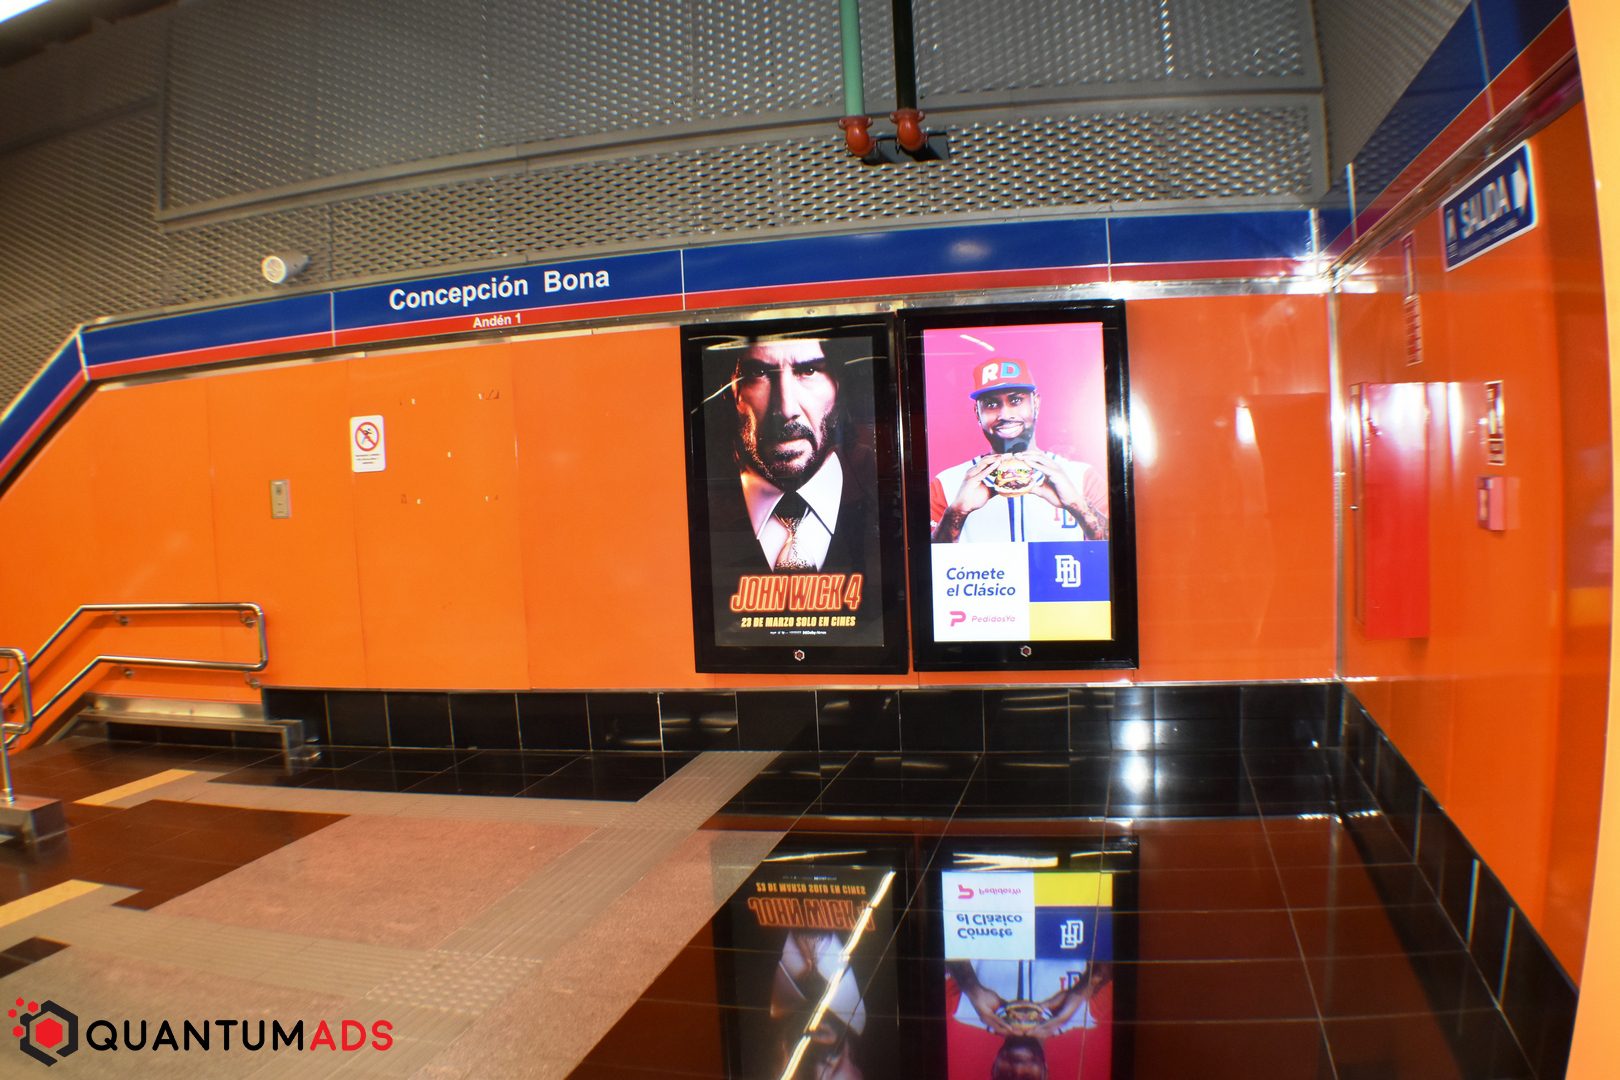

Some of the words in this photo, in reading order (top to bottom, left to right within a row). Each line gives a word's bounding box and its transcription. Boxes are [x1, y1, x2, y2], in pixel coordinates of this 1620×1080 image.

[389, 275, 528, 311] Concepción
[544, 269, 610, 293] Bona
[473, 313, 511, 328] Andén
[515, 312, 522, 325] 1
[982, 361, 1021, 385] RD
[946, 567, 1005, 581] Cómete
[730, 574, 789, 612] JOHN
[789, 573, 845, 612] WICK
[844, 571, 863, 611] 4
[946, 584, 959, 596] el
[963, 583, 1016, 596] Clásico
[741, 617, 752, 628] 23
[753, 617, 764, 628] DE
[765, 617, 795, 627] MARZO
[796, 616, 817, 627] SOLO
[818, 616, 830, 627] EN
[831, 616, 856, 627] CINES
[972, 615, 1016, 623] PedidosYa
